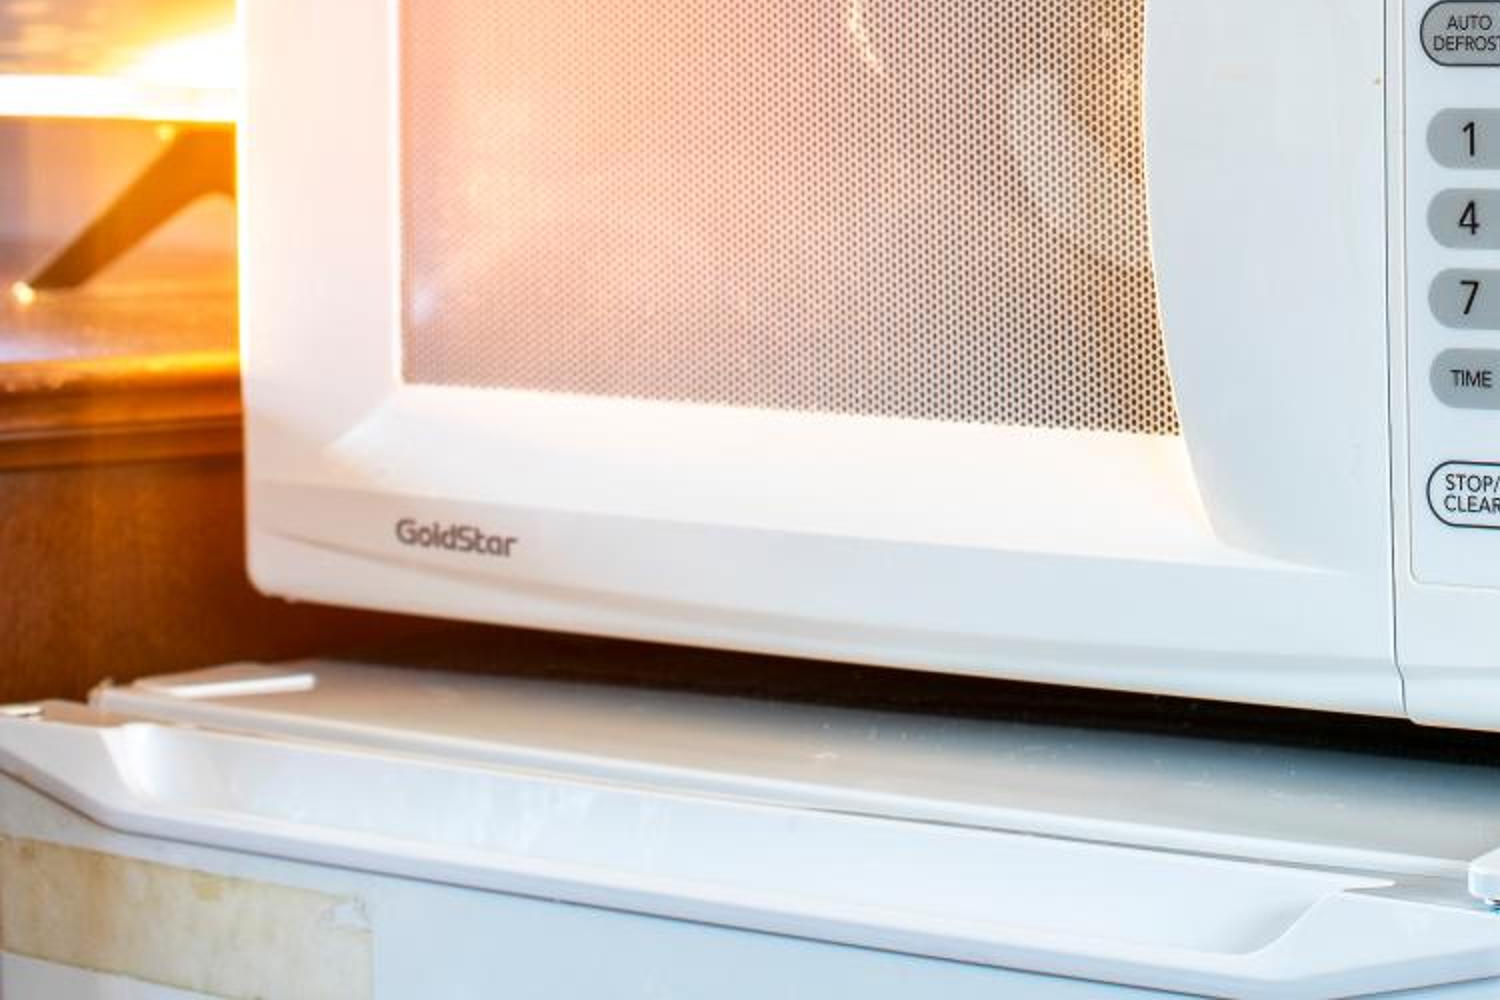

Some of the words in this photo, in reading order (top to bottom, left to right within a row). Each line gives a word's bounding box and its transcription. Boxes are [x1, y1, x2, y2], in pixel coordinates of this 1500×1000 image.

[1447, 14, 1493, 31] AUTO
[1462, 121, 1476, 157] 1
[1458, 200, 1480, 235] 4
[1459, 280, 1480, 315] 7
[1450, 369, 1493, 389] TIME
[1445, 473, 1500, 493] STOP/
[395, 517, 518, 558] GoldStar
